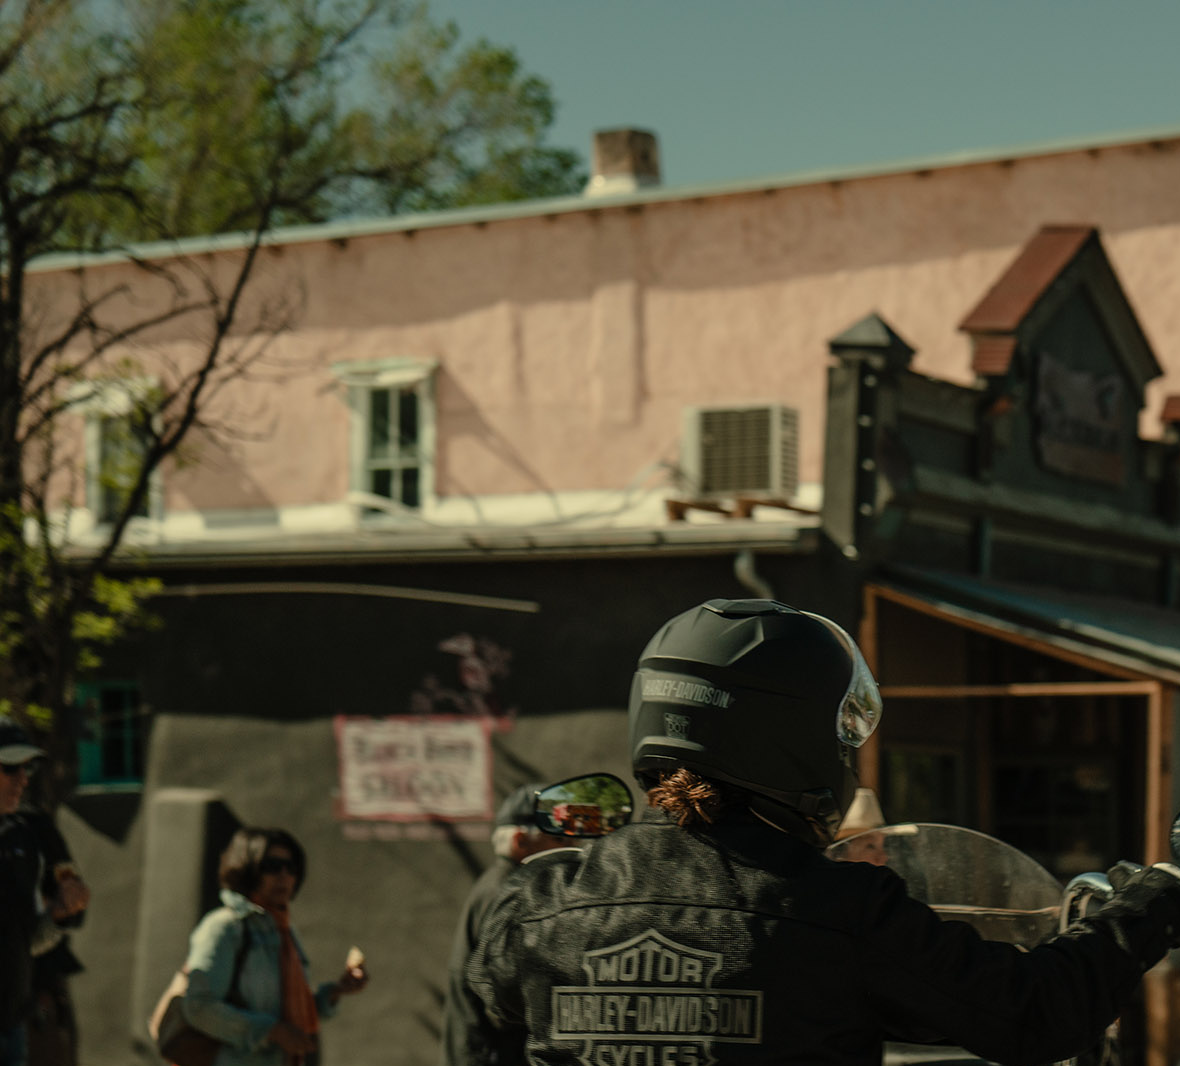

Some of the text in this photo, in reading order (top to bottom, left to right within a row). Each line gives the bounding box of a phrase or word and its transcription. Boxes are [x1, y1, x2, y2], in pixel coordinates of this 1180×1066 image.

[642, 679, 730, 708] HARLEY-DAVIDSON
[598, 940, 703, 983] MOTOR
[560, 995, 751, 1034] HARLEY-DAVIDSON
